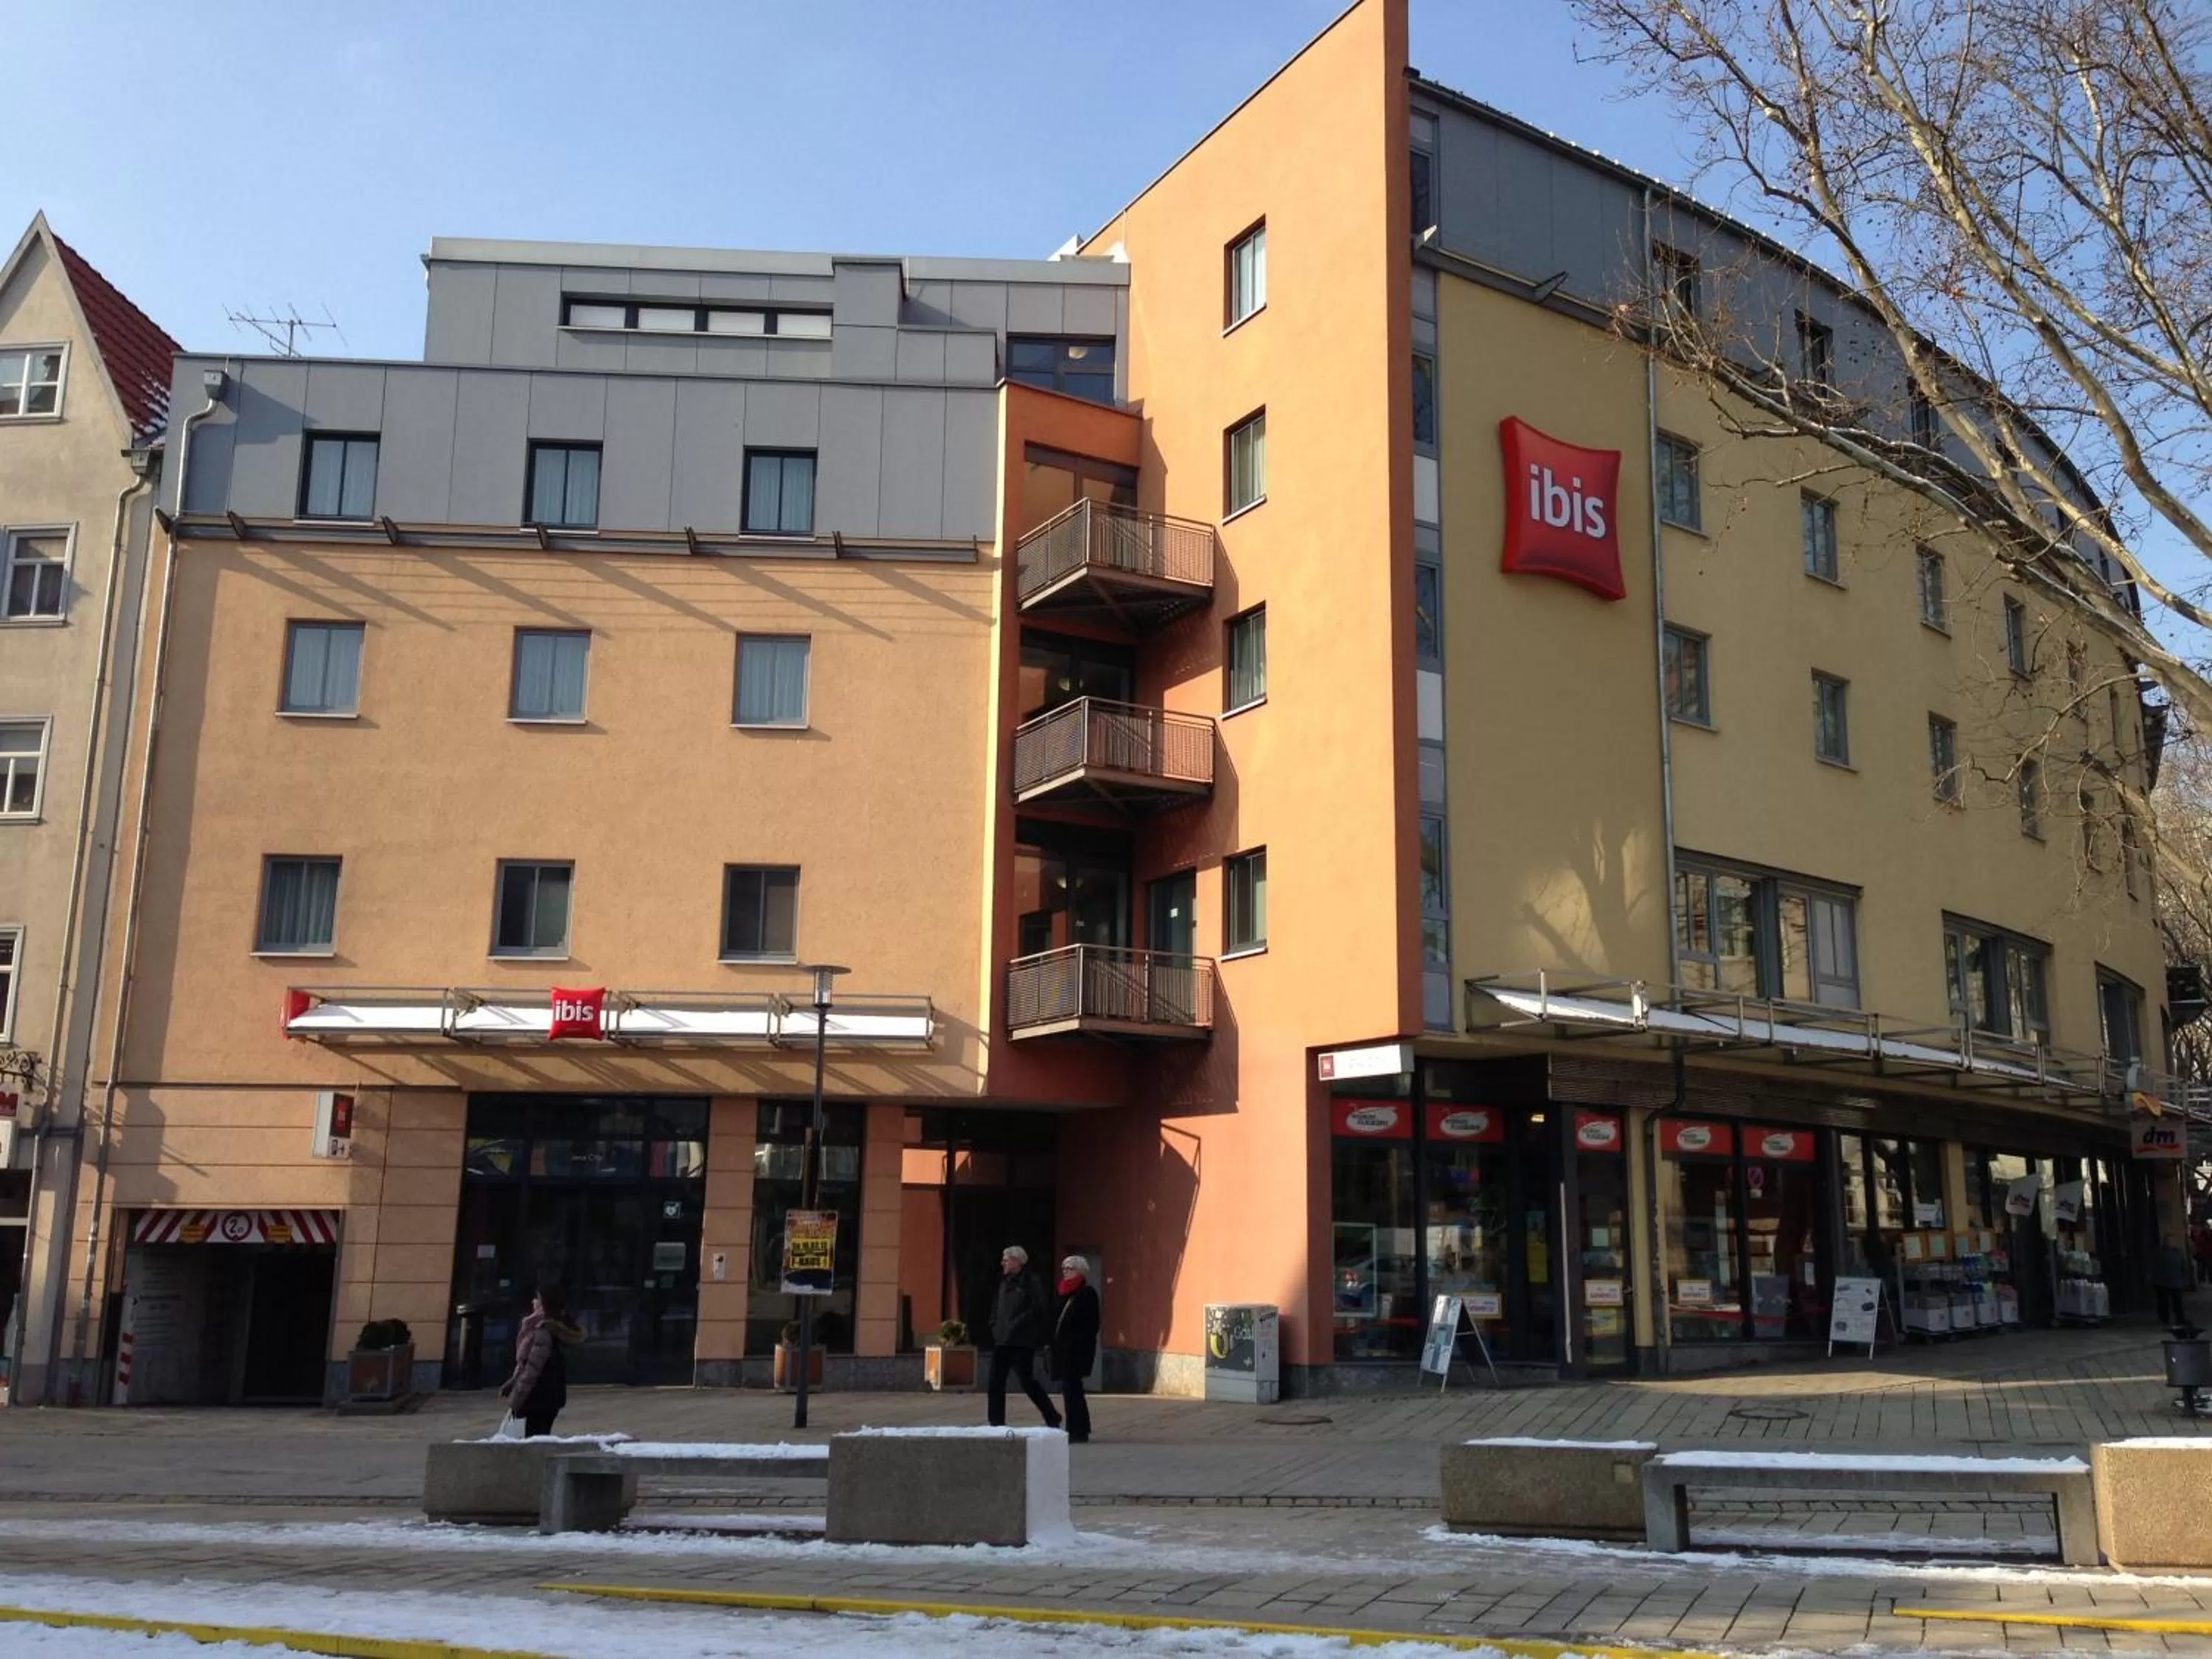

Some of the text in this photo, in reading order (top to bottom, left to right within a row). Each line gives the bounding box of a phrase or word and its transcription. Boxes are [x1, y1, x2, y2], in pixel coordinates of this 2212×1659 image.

[1529, 463, 1606, 538] ibis
[554, 999, 594, 1022] ibis
[2143, 1126, 2175, 1144] dm
